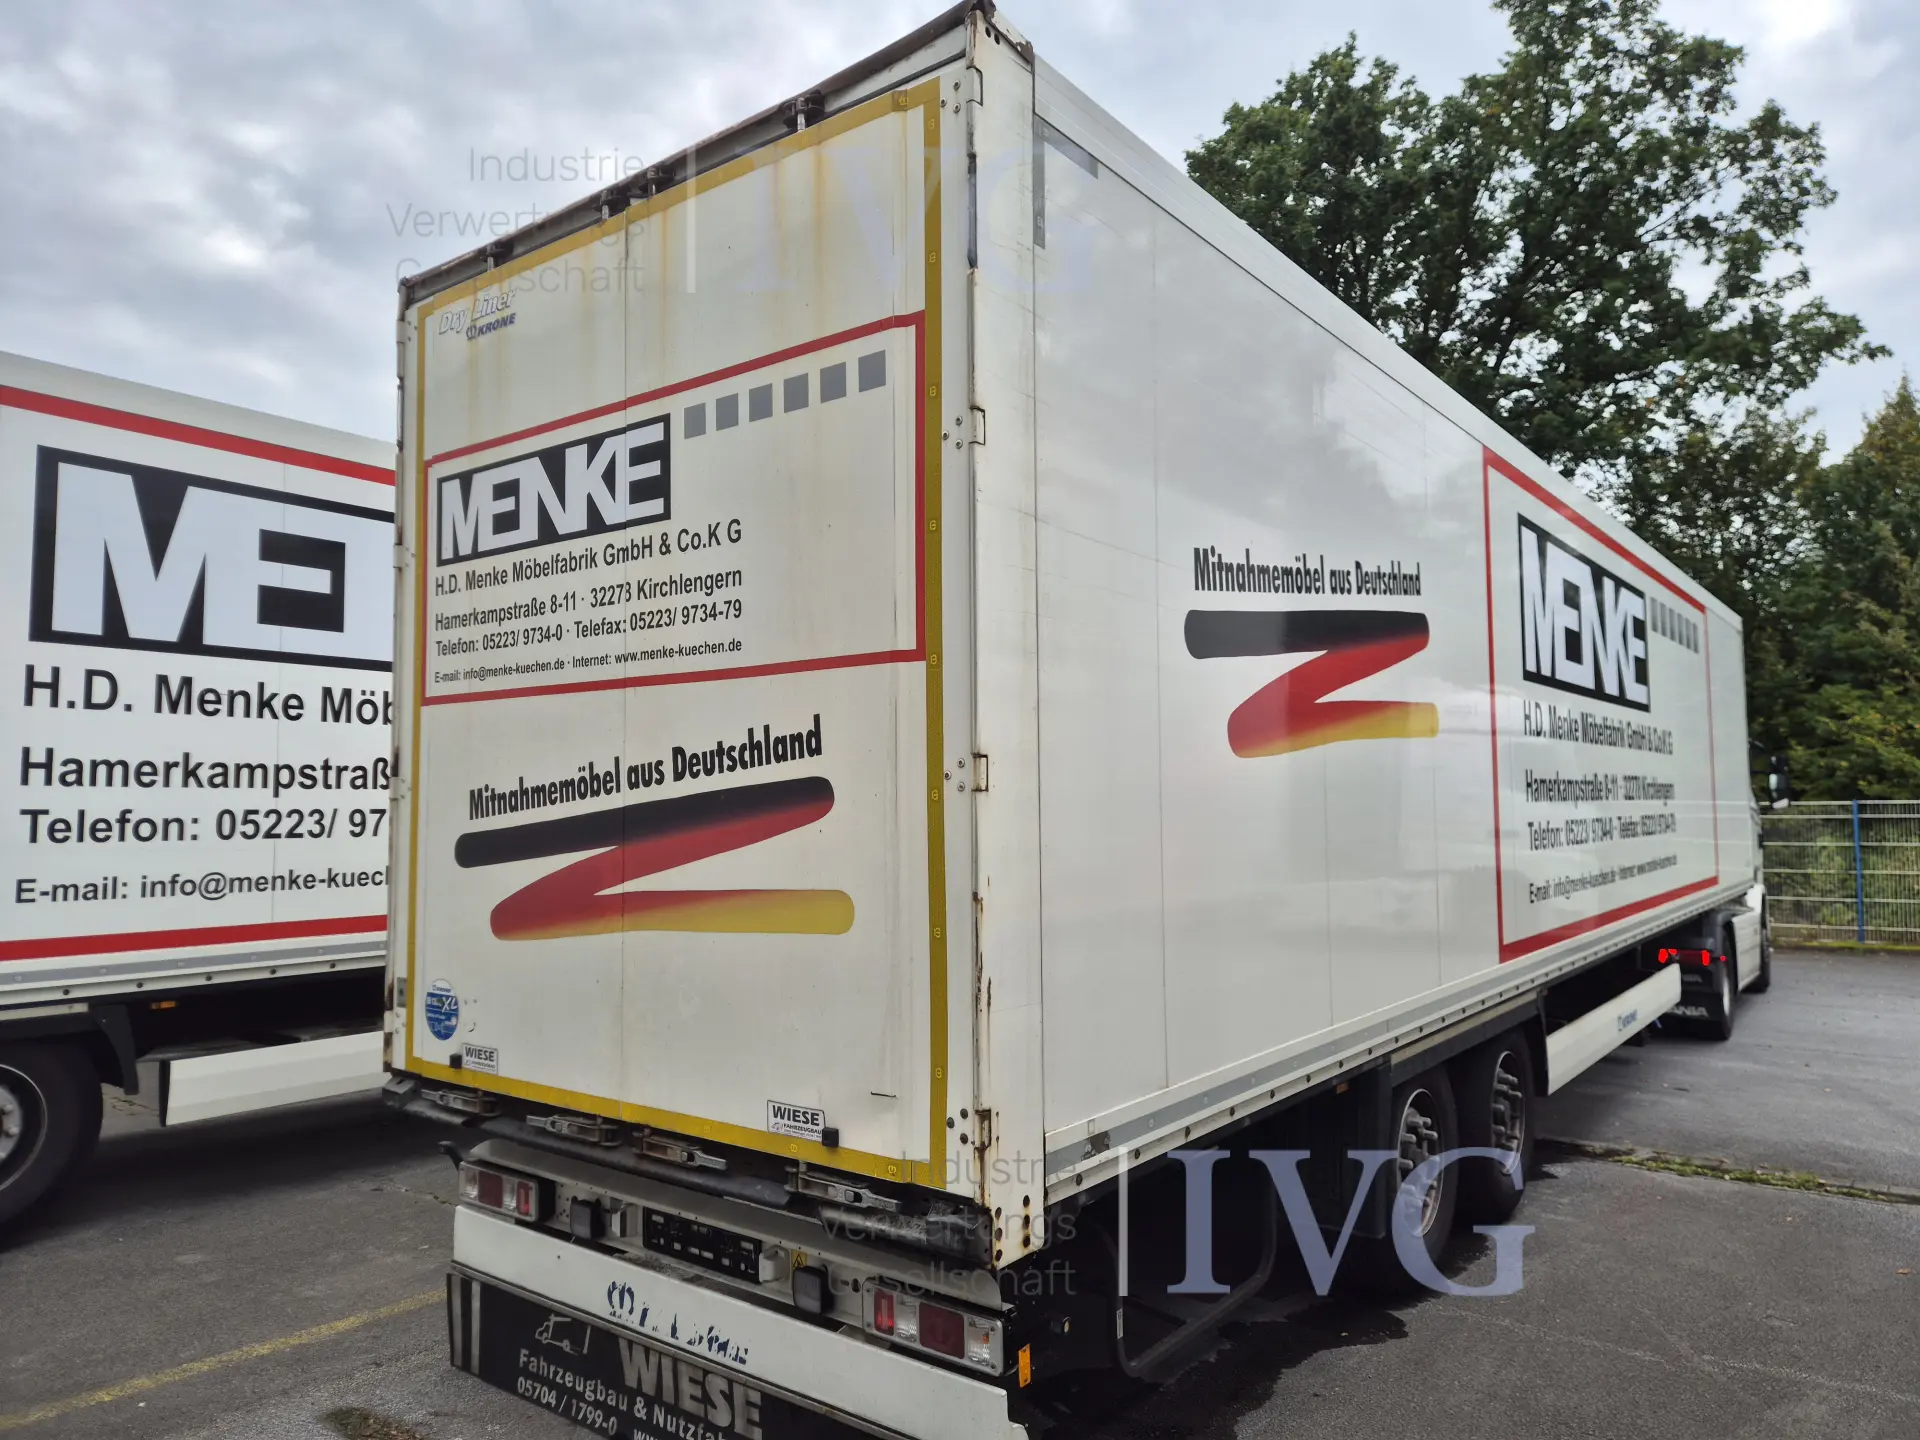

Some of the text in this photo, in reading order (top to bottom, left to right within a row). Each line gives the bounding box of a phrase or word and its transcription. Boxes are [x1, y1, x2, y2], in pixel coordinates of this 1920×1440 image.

[439, 309, 470, 335] Dry
[478, 312, 516, 336] KRONE
[441, 421, 664, 561] MENKE
[435, 573, 461, 597] H.D.
[465, 566, 508, 592] Menke
[512, 547, 598, 583] Möbelfabrik
[603, 535, 653, 566] GmbH
[658, 532, 672, 555] &
[1193, 544, 1422, 597] Mitnahmemöbel aus Deutschland
[435, 597, 546, 632] Hamerkampstraße
[550, 591, 577, 614] 8-11
[637, 569, 742, 601] Kirchlengern
[1521, 525, 1648, 703] MENKE
[435, 637, 479, 657] Telefon:
[574, 617, 627, 638] Telefax:
[434, 638, 742, 684] E-mail: info@menke-kuechen.de Internet: www.menke-kuechen.de
[22, 663, 134, 713] H.D.
[154, 673, 305, 722] Menke
[1523, 699, 1547, 738] H.D.
[1548, 704, 1580, 743] Menke
[468, 713, 823, 821] Mitnahmemöbel aus Deutschland
[1525, 768, 1604, 809] Hamerkampstraße
[18, 807, 200, 844] Telefon:
[1527, 821, 1564, 851] Telefon:
[14, 875, 129, 904] E-mail:
[464, 1046, 495, 1063] WIESE
[772, 1104, 820, 1127] WIESE
[517, 1376, 557, 1408] 05704
[571, 1399, 618, 1436] 1799-0
[518, 1348, 628, 1412] Fahrzeugbau
[633, 1395, 647, 1421] &
[618, 1336, 763, 1440] WIESE
